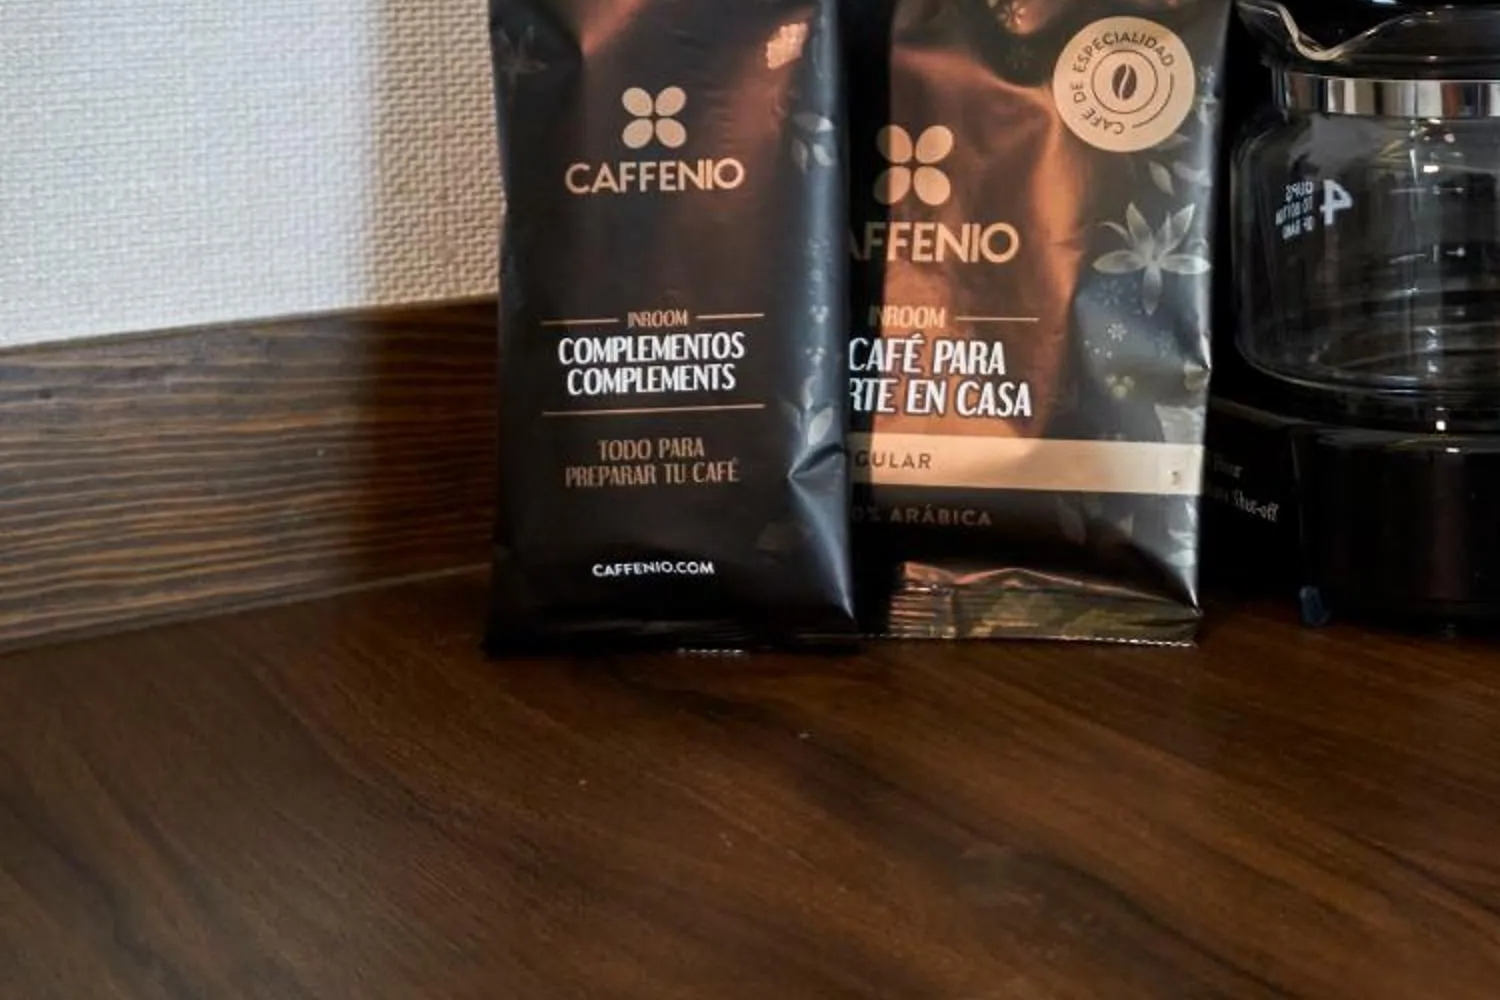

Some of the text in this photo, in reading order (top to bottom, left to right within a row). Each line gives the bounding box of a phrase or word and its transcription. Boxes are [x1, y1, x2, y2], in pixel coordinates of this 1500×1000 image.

[1072, 31, 1174, 73] ESPECIALIDAD
[1070, 80, 1086, 104] DE
[565, 158, 746, 194] CAFFENIO
[849, 221, 1020, 264] FFENIO
[627, 310, 688, 328] INROOM
[558, 332, 745, 365] COMPLEMENTOS
[849, 333, 1006, 375] CAFÉ PARA
[567, 363, 736, 396] COMPLEMENTS
[849, 377, 1032, 418] RTE EN CASA
[598, 437, 705, 461] TODO PARA
[855, 450, 932, 470] GULAR
[565, 463, 656, 488] PREPARAR
[664, 463, 685, 483] TU
[890, 503, 992, 527] ARÁBICA
[592, 561, 715, 577] CAFFENIO.COM
